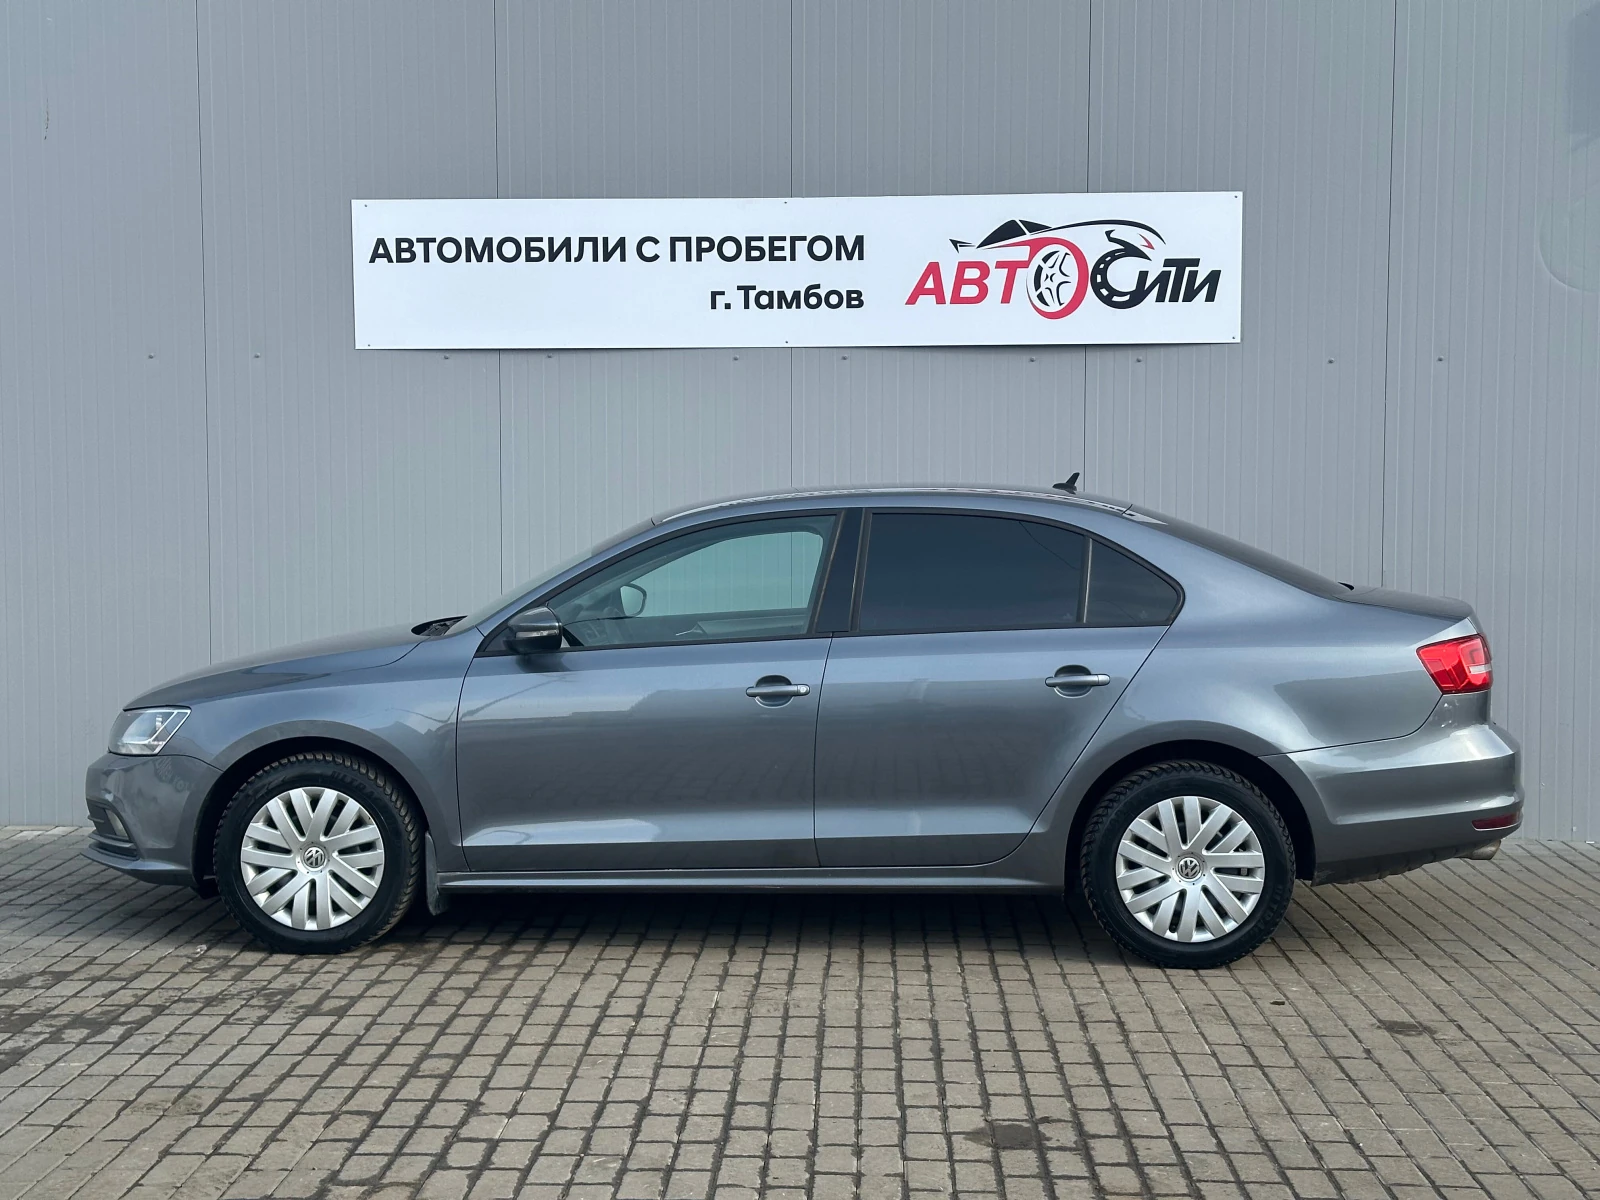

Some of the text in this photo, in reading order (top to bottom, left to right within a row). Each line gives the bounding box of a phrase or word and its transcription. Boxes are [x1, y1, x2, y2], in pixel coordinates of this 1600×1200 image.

[369, 235, 865, 263] АВТОМОБИЛИ С ПРОБЕГОМ
[710, 284, 865, 310] г. Тамбов
